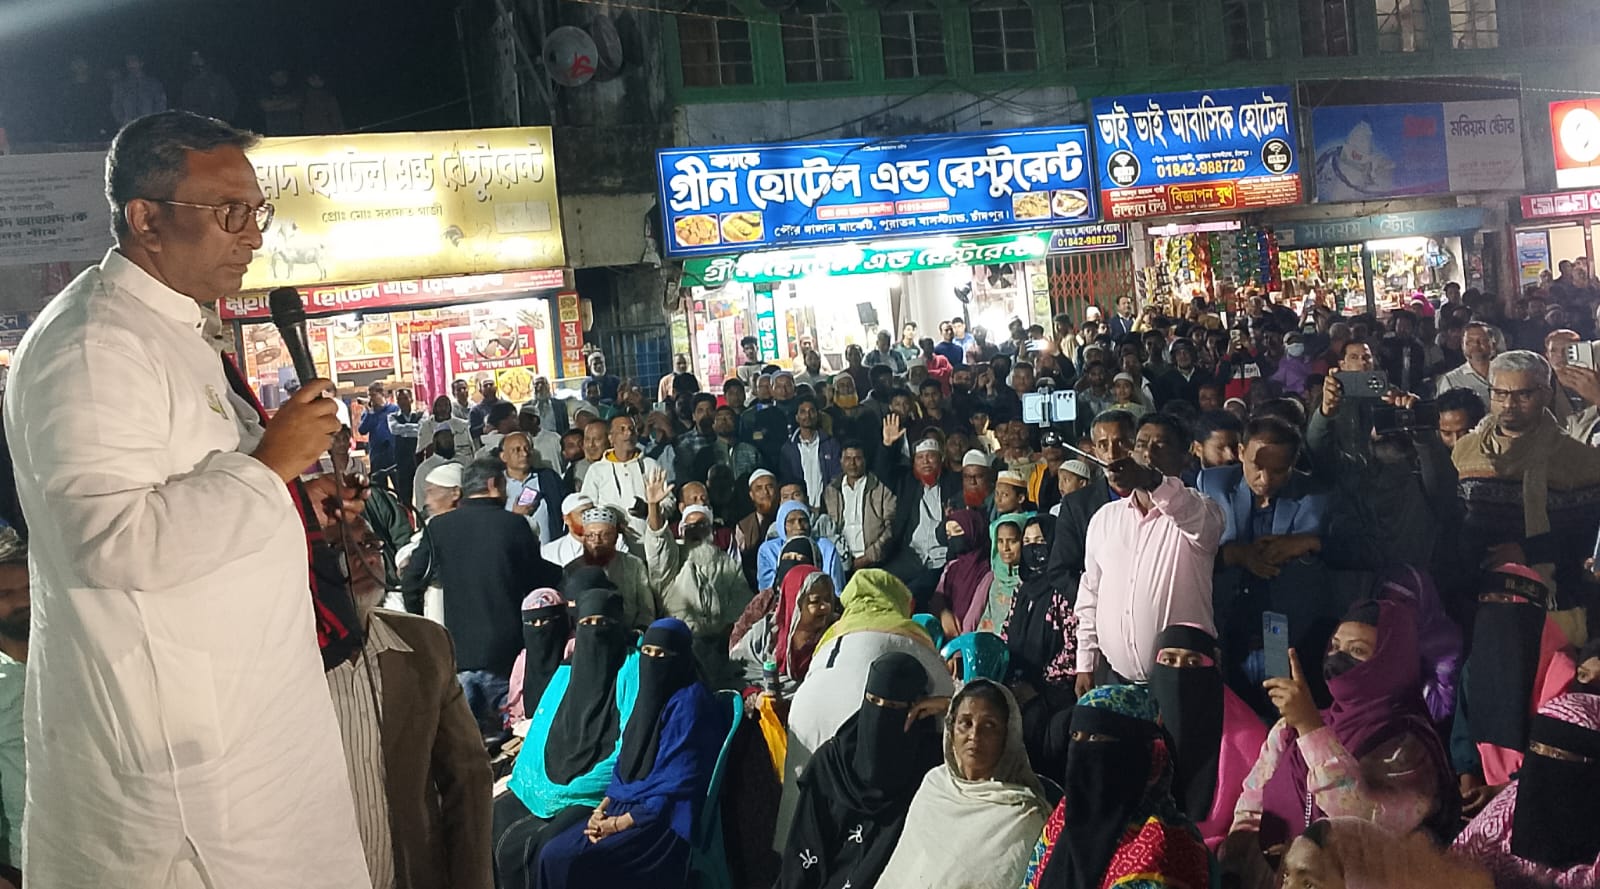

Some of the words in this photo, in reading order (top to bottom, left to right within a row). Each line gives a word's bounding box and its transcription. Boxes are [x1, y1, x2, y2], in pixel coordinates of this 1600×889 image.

[1096, 101, 1132, 150] ভাই
[1131, 98, 1168, 149] ভাই
[1167, 94, 1233, 143] আবাসিক
[1238, 91, 1289, 142] হোটেল
[1449, 114, 1486, 137] মরিয়ম
[670, 156, 737, 212] গ্রীন
[747, 157, 862, 210] হোটেল
[870, 159, 930, 194] এন্ড
[938, 141, 1083, 198] রেস্টুরেন্ট
[1156, 158, 1245, 178] 01842-988720
[1171, 186, 1213, 204] বিজ্ঞাপন
[1215, 185, 1232, 204] বুথ
[1057, 235, 1117, 247] 01842-988720
[314, 282, 380, 306] হোটেল
